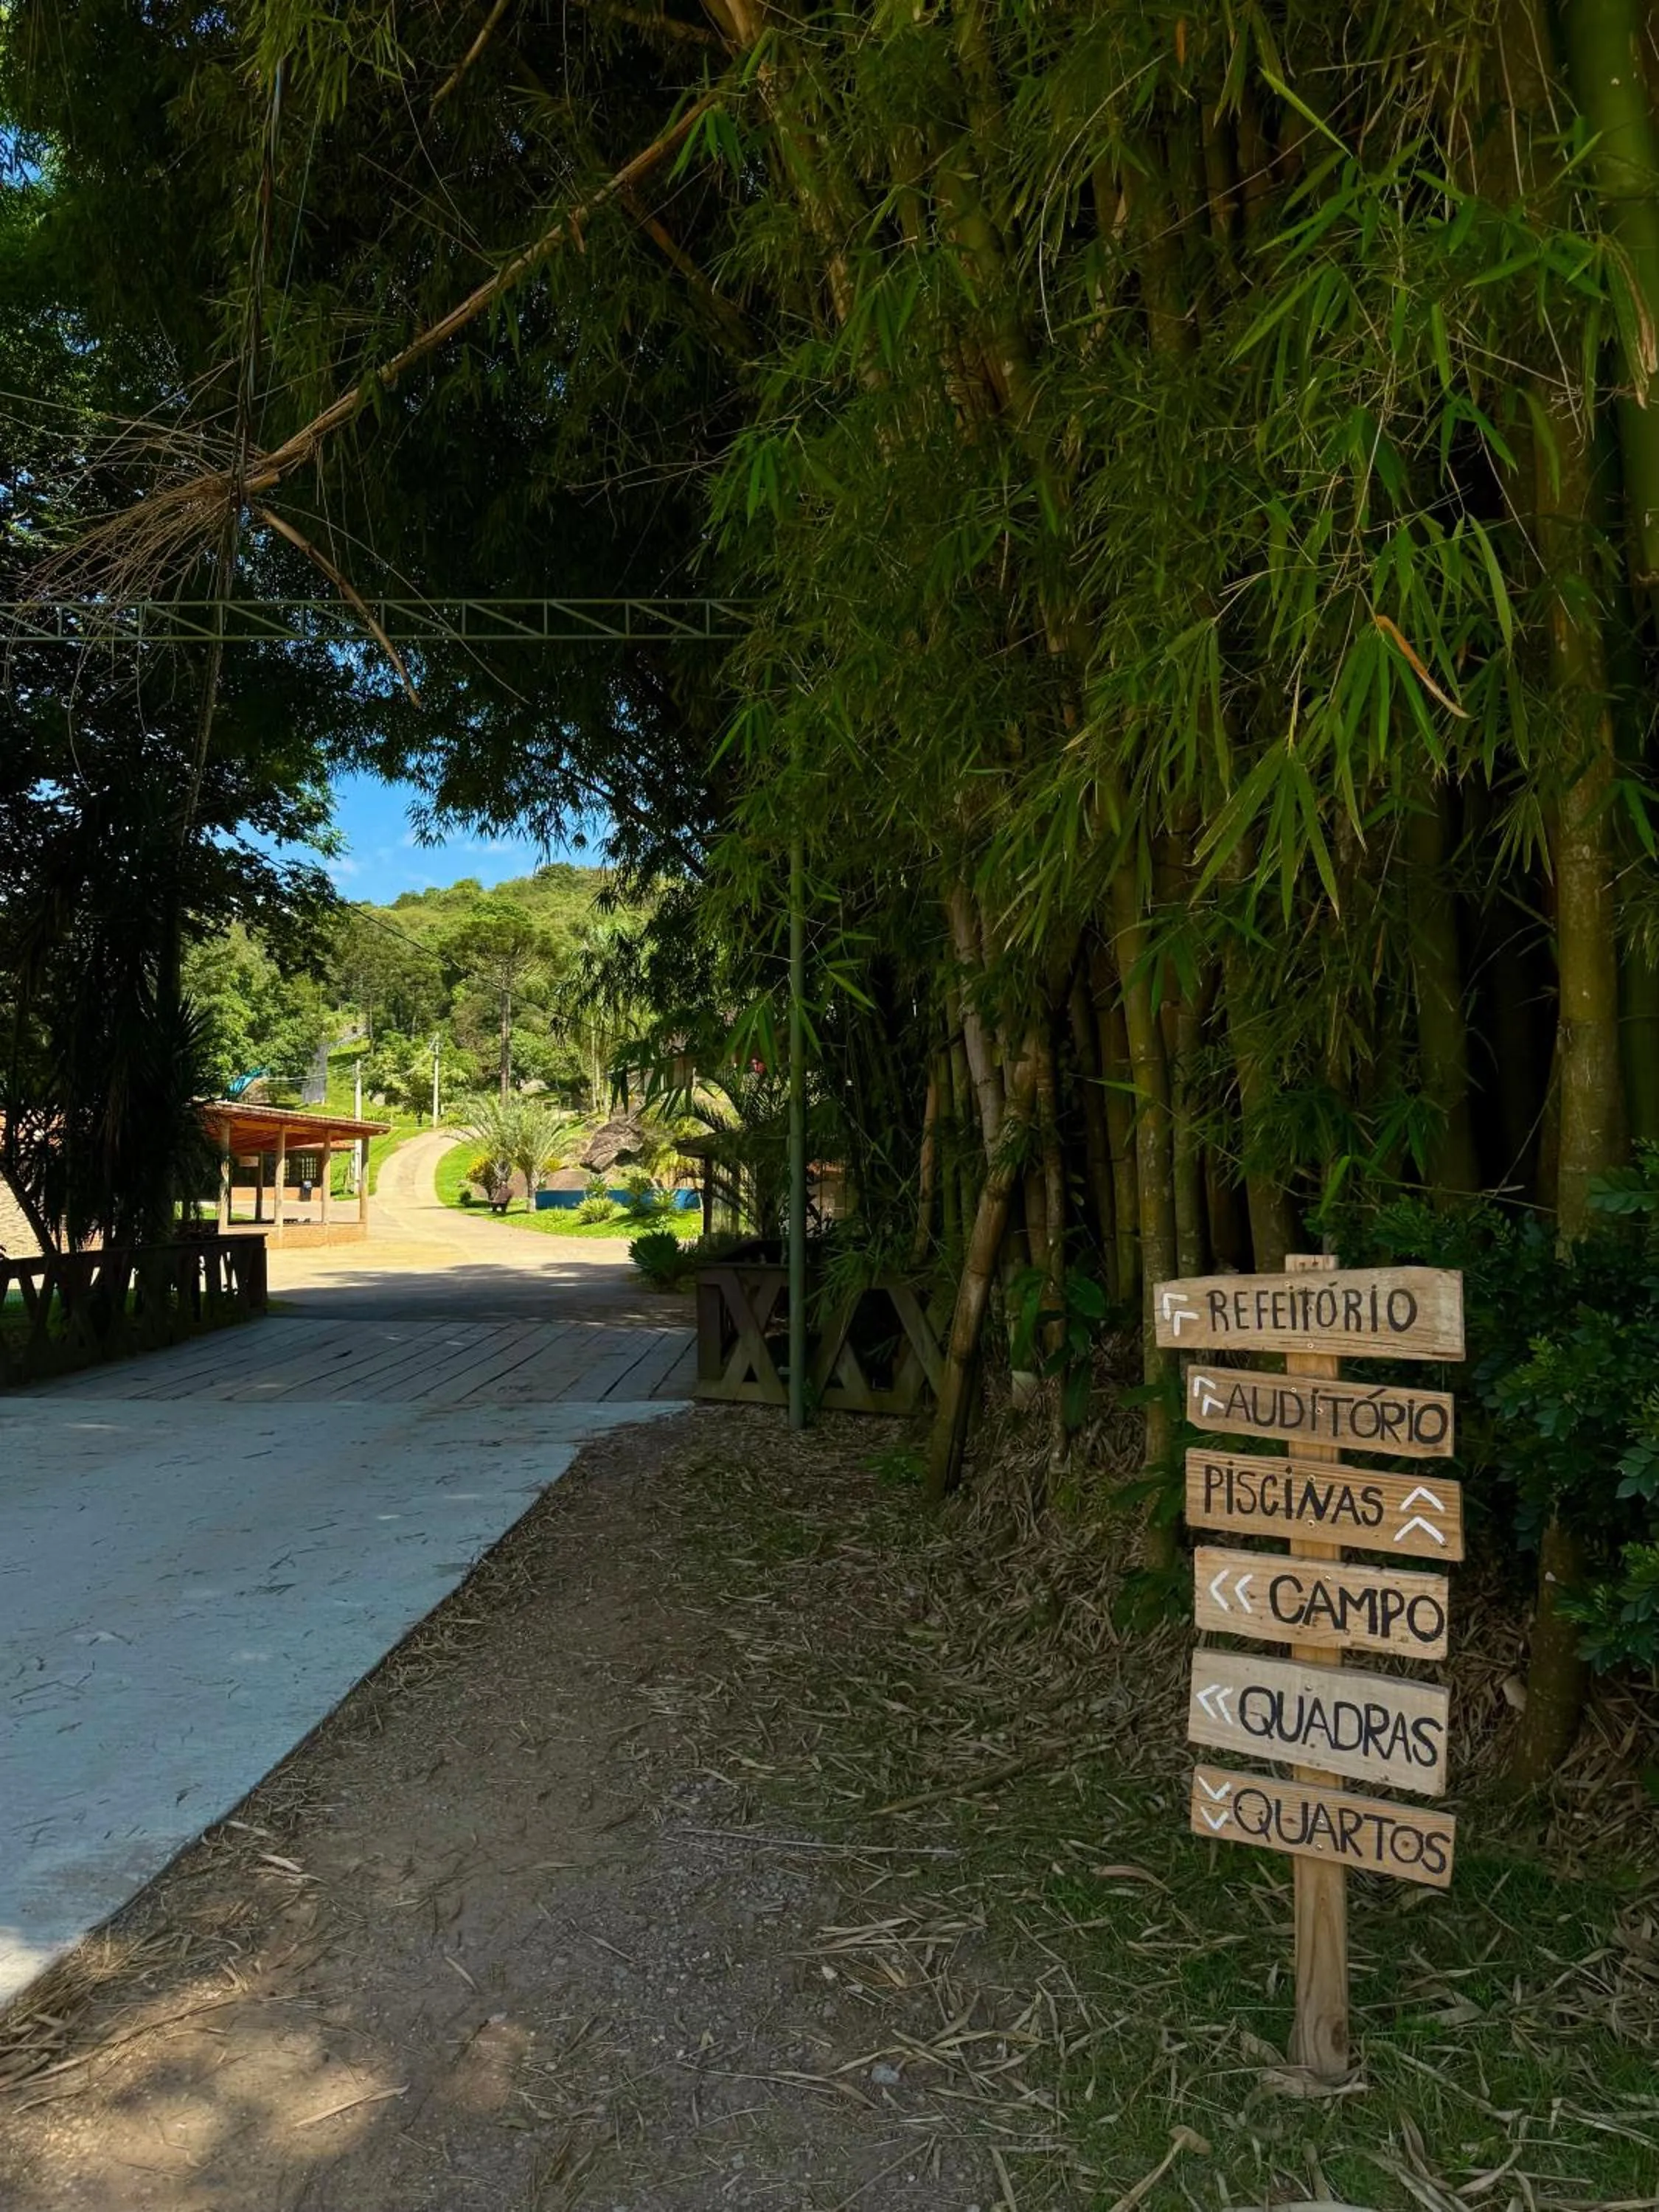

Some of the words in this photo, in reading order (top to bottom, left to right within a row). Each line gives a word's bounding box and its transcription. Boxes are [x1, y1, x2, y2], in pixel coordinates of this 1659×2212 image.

[1269, 1574, 1445, 1643] CAMPO
[1238, 1686, 1443, 1767] QUADRAS
[1233, 1788, 1451, 1874] QUARTOS
